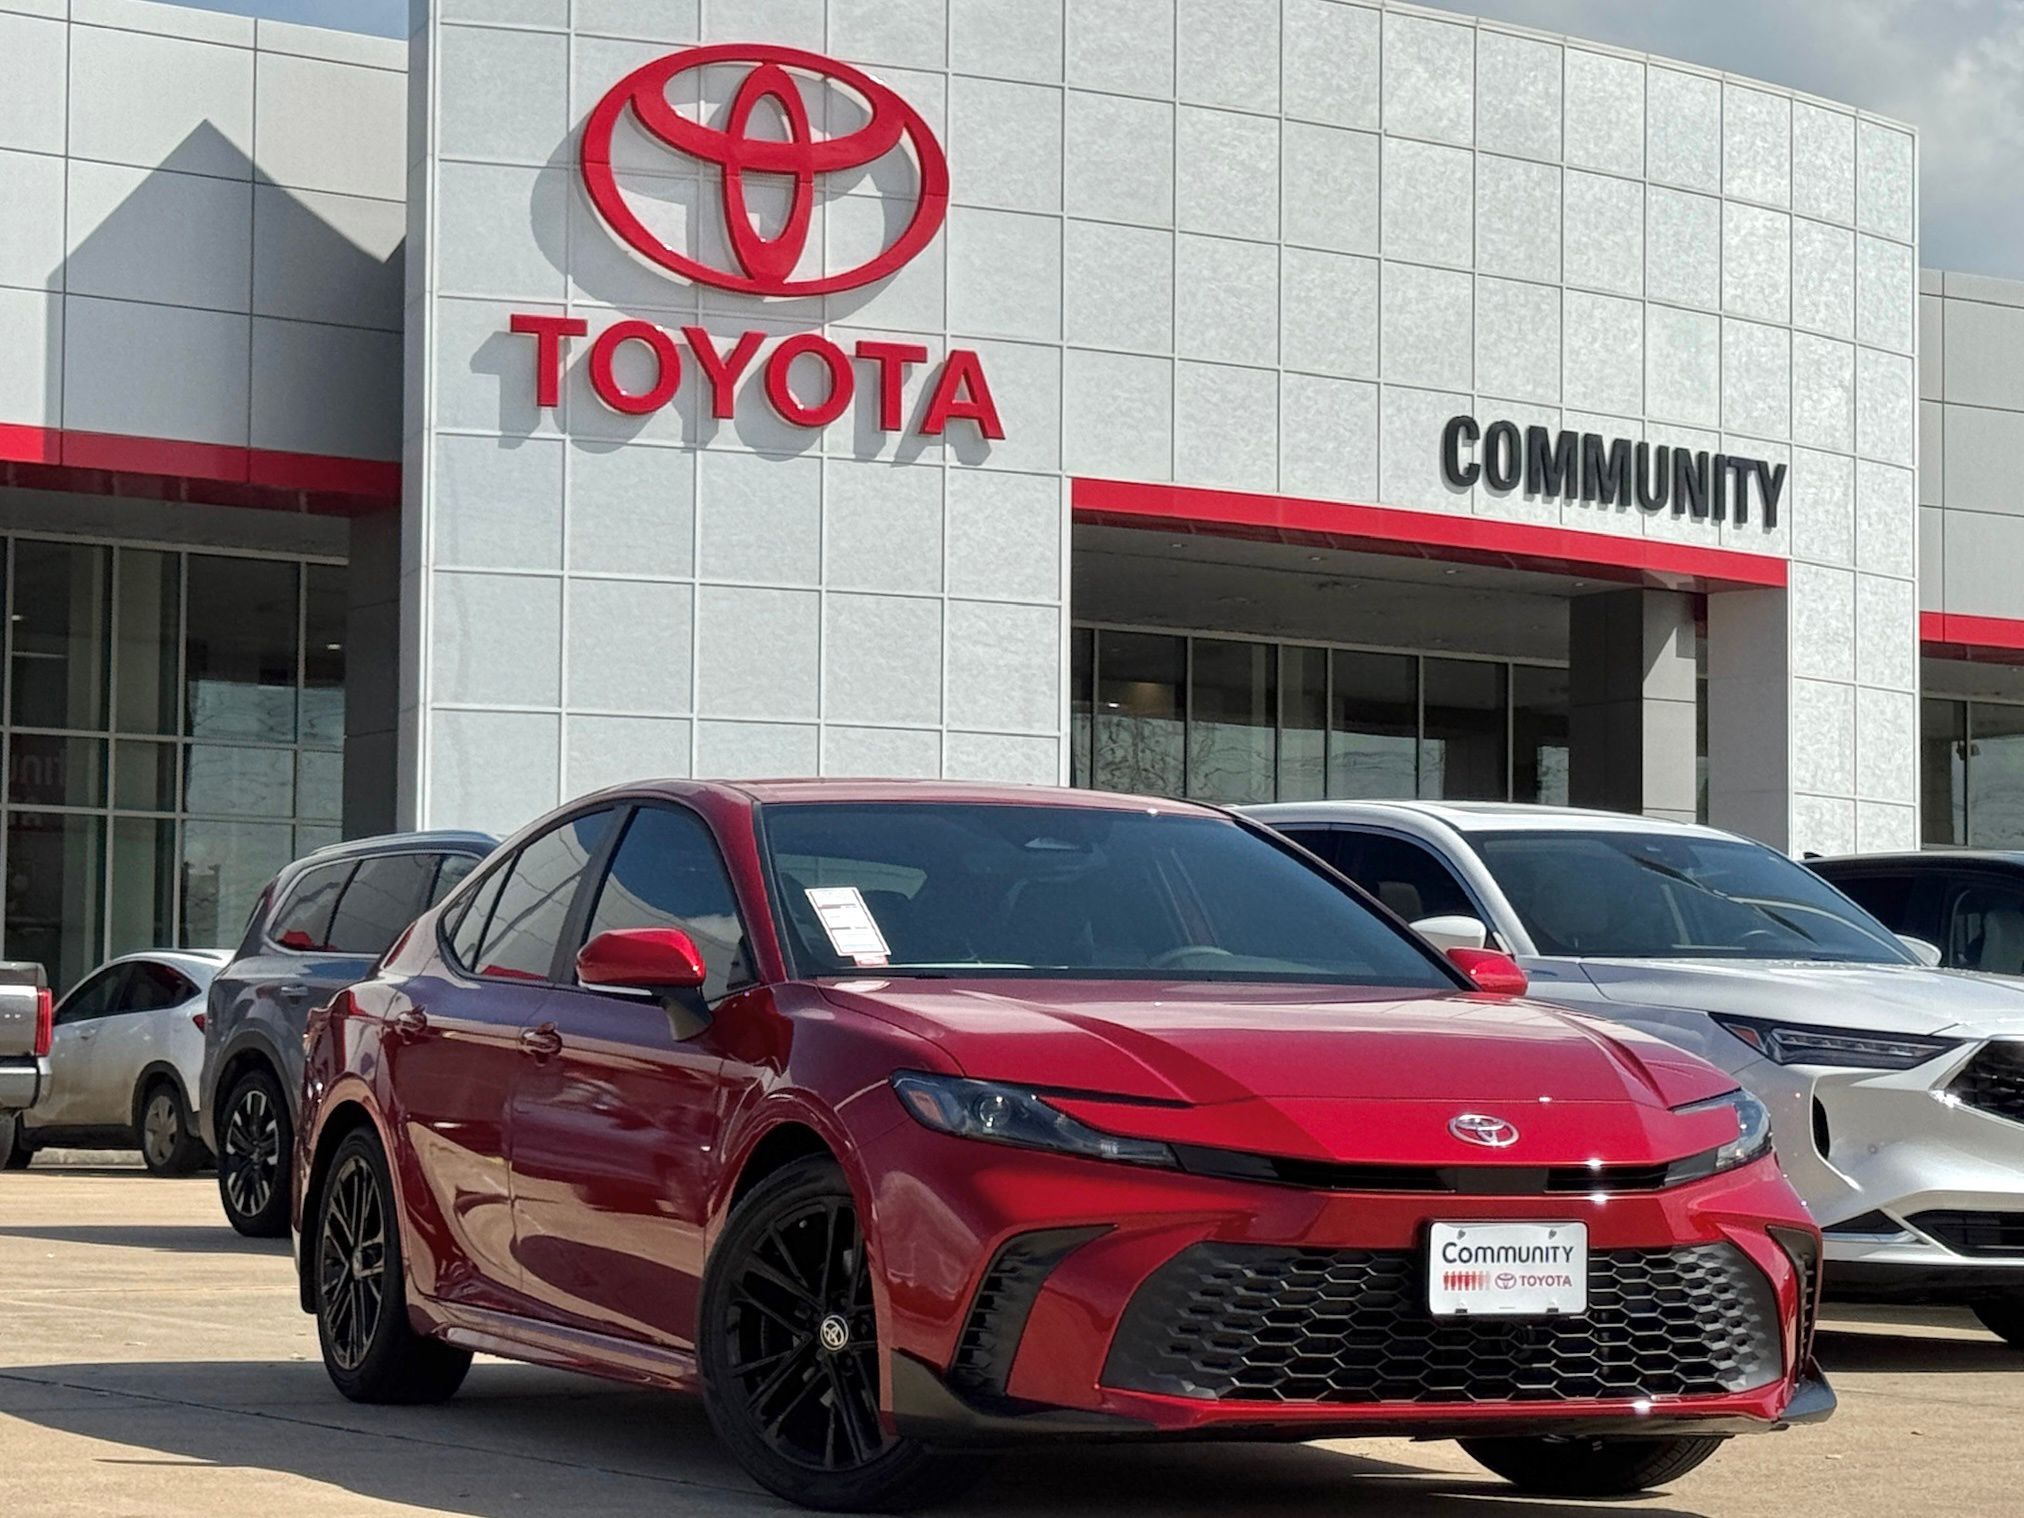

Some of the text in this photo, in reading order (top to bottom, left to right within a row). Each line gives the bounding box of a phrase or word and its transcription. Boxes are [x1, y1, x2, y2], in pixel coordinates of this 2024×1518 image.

[510, 313, 1006, 440] TOYOTA
[1443, 415, 1788, 529] COMMUNITY
[1519, 1274, 1573, 1288] TOYOTA
